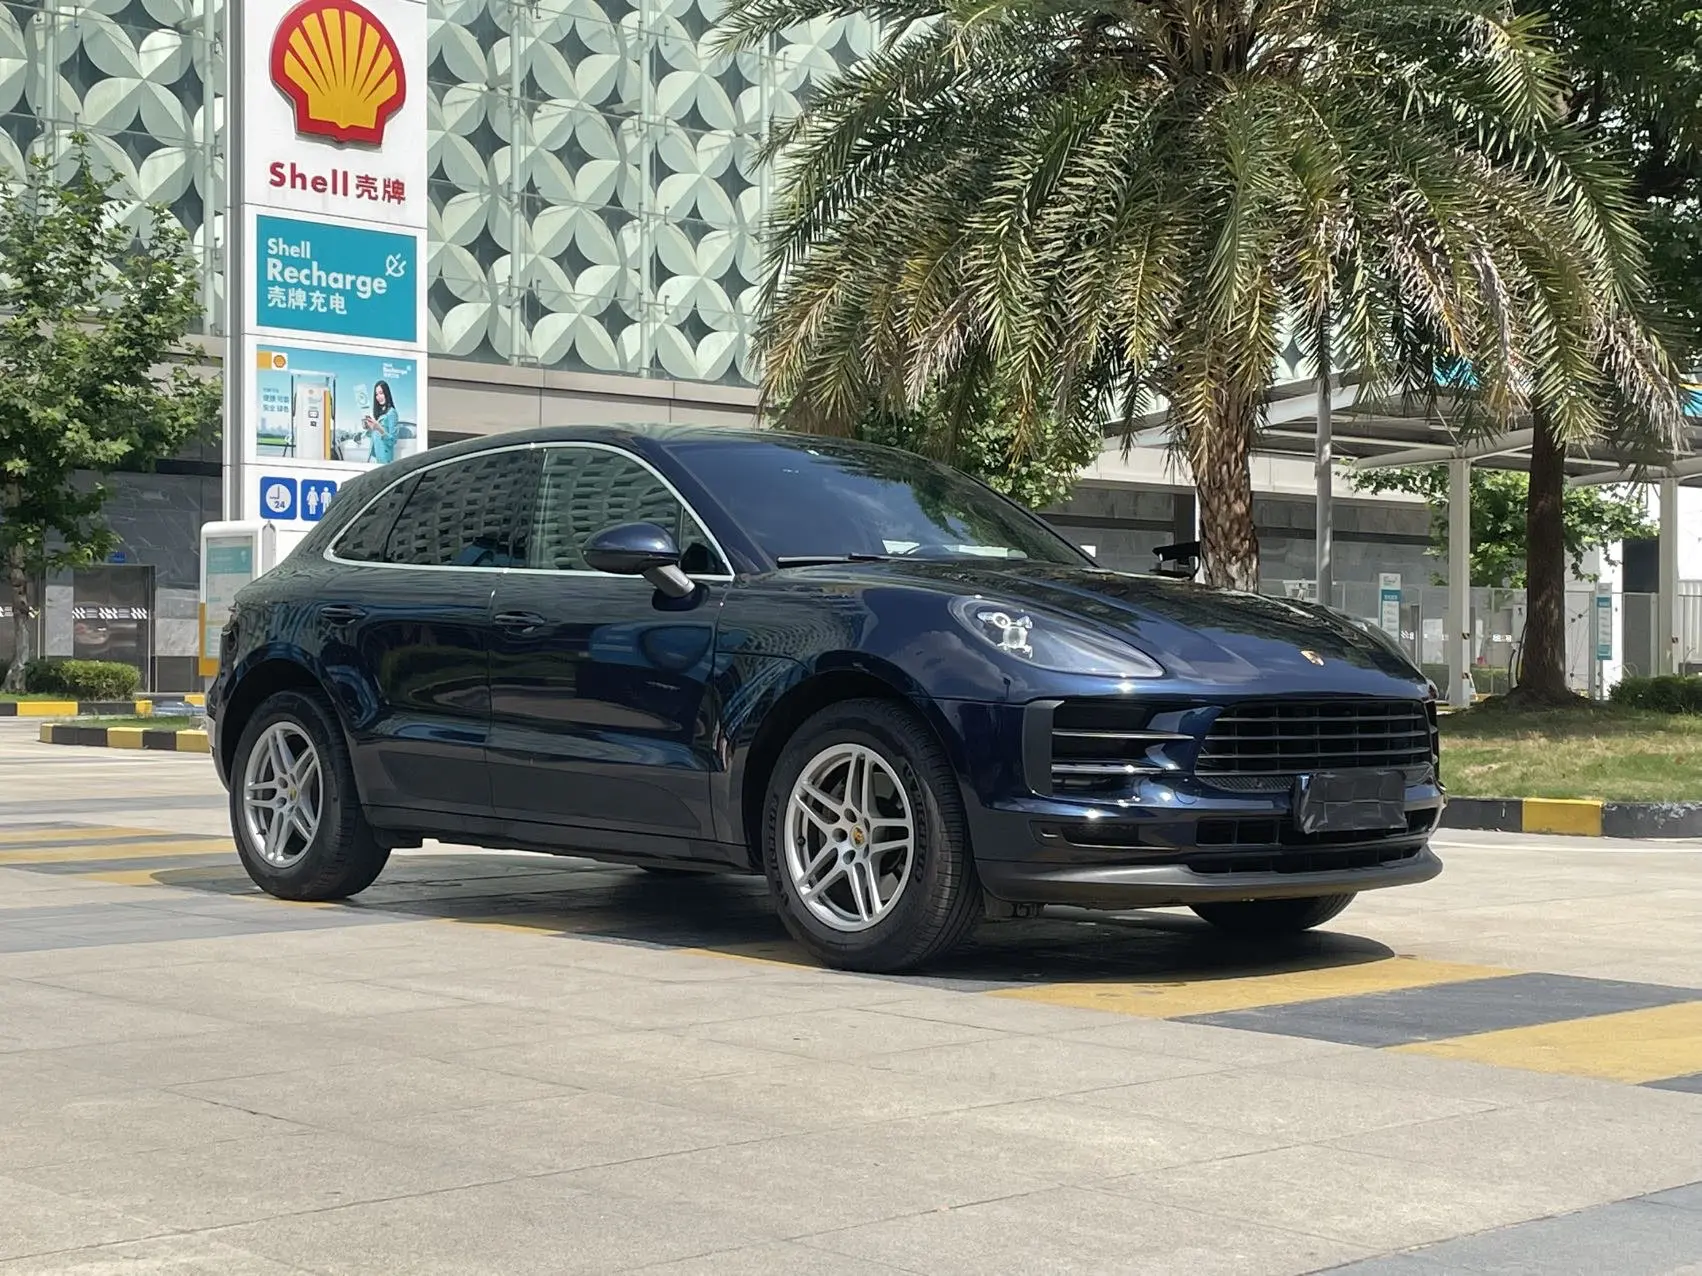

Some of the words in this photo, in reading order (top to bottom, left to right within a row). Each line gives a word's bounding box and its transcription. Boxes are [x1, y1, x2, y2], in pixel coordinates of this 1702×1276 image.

[269, 162, 348, 197] Shell
[355, 174, 406, 205] 壳牌
[267, 238, 311, 259] Shell
[266, 258, 388, 299] Recharge
[267, 286, 348, 315] 壳牌充电
[274, 500, 286, 509] 24
